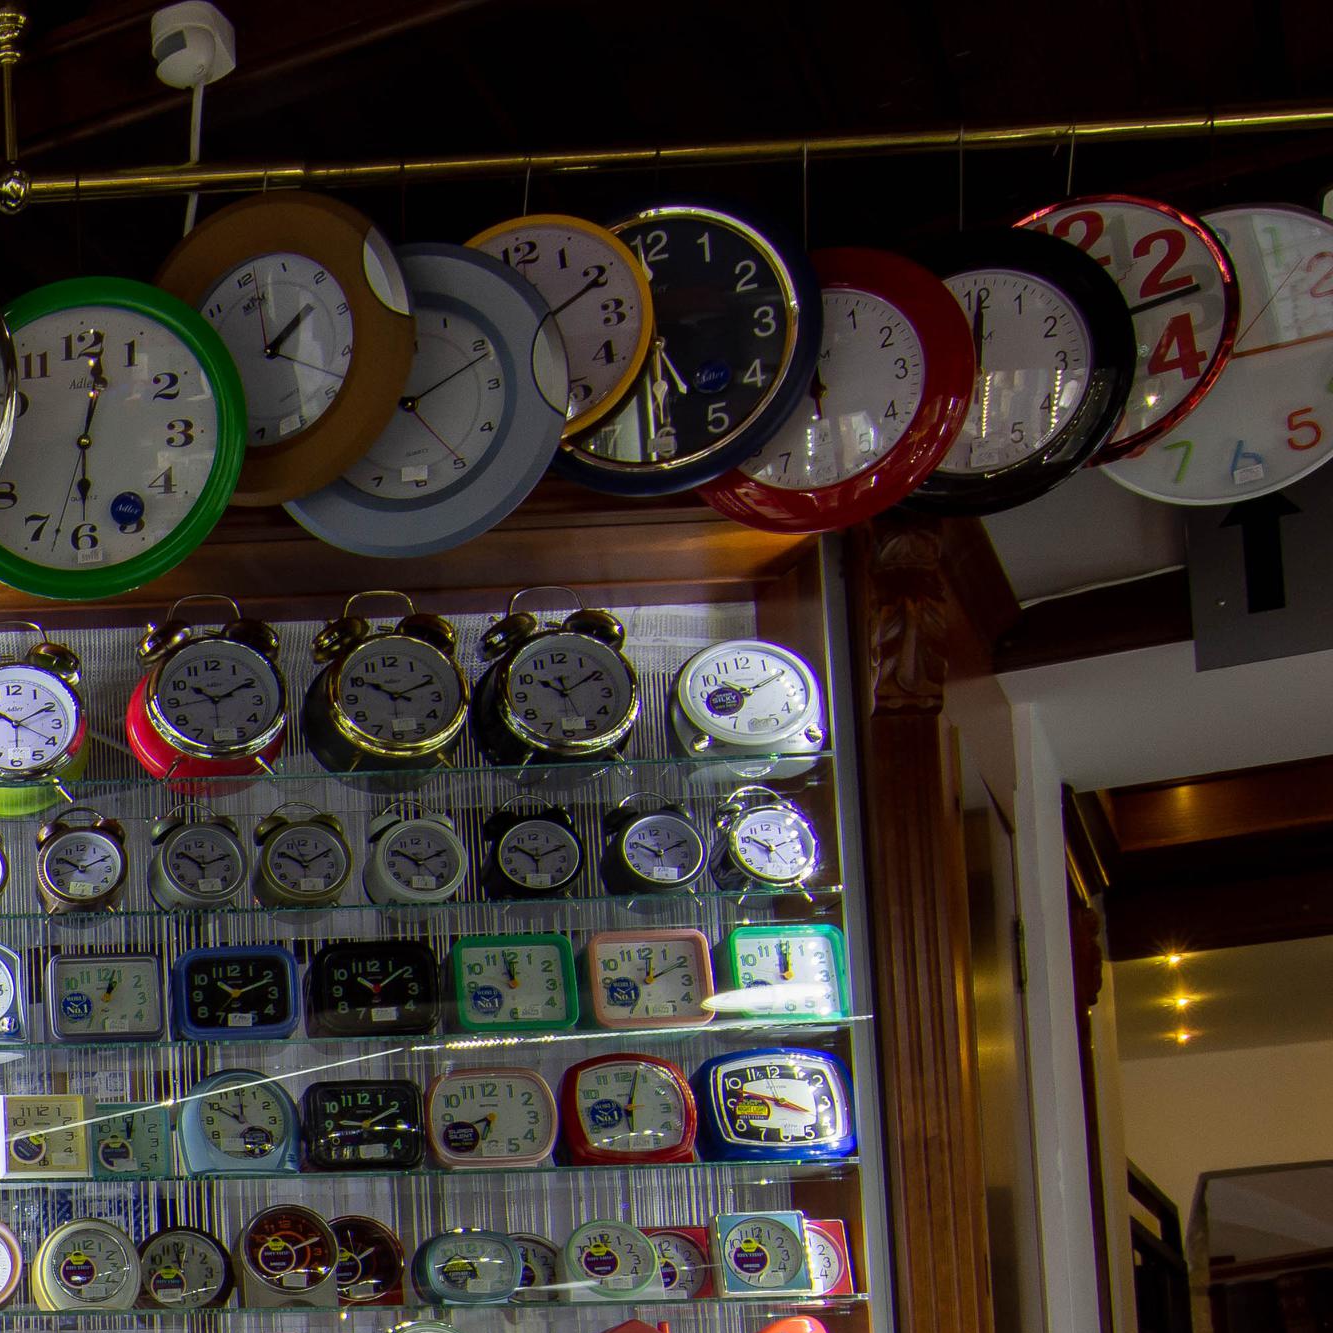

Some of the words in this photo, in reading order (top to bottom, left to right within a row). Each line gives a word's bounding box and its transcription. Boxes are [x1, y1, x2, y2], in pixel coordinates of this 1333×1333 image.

[630, 230, 669, 263] 12
[697, 232, 711, 263] 1
[558, 247, 567, 269] 1
[1133, 229, 1193, 298] 2
[237, 273, 254, 289] 12
[313, 271, 327, 284] 2
[583, 265, 608, 286] 2
[735, 260, 758, 292] 2
[336, 302, 349, 316] 3
[601, 298, 626, 326] 3
[753, 306, 777, 337] 3
[1044, 316, 1057, 338] 2
[60, 330, 104, 361] 12
[473, 339, 486, 352] 2
[879, 326, 893, 349] 2
[1148, 312, 1207, 380] 4
[124, 340, 138, 367] 1
[592, 340, 617, 365] 4
[1055, 351, 1068, 371] 3
[21, 351, 50, 380] 11
[743, 358, 766, 387] 4
[895, 358, 908, 379] 3
[153, 373, 180, 400] 2
[488, 378, 501, 390] 3
[707, 402, 730, 433] 5
[885, 400, 897, 421] 4
[166, 419, 194, 447] 3
[255, 427, 266, 439] 7
[480, 421, 494, 432] 4
[1011, 422, 1023, 443] 5
[1288, 408, 1321, 450] 5
[780, 452, 791, 473] 7
[1164, 441, 1193, 482] 7
[147, 466, 178, 494] 4
[116, 503, 140, 516] Adler
[24, 514, 50, 541] 7
[71, 524, 98, 549] 6
[204, 660, 220, 672] 12
[734, 657, 750, 670] 12
[6, 685, 22, 696] 12
[702, 675, 717, 687] 10
[711, 696, 738, 706] SILKY
[51, 718, 62, 730] 3
[477, 1000, 500, 1009] No.1
[613, 991, 636, 1001] No.1
[766, 1066, 780, 1079] 12
[813, 1075, 824, 1088] 2
[595, 1114, 619, 1123] No.1
